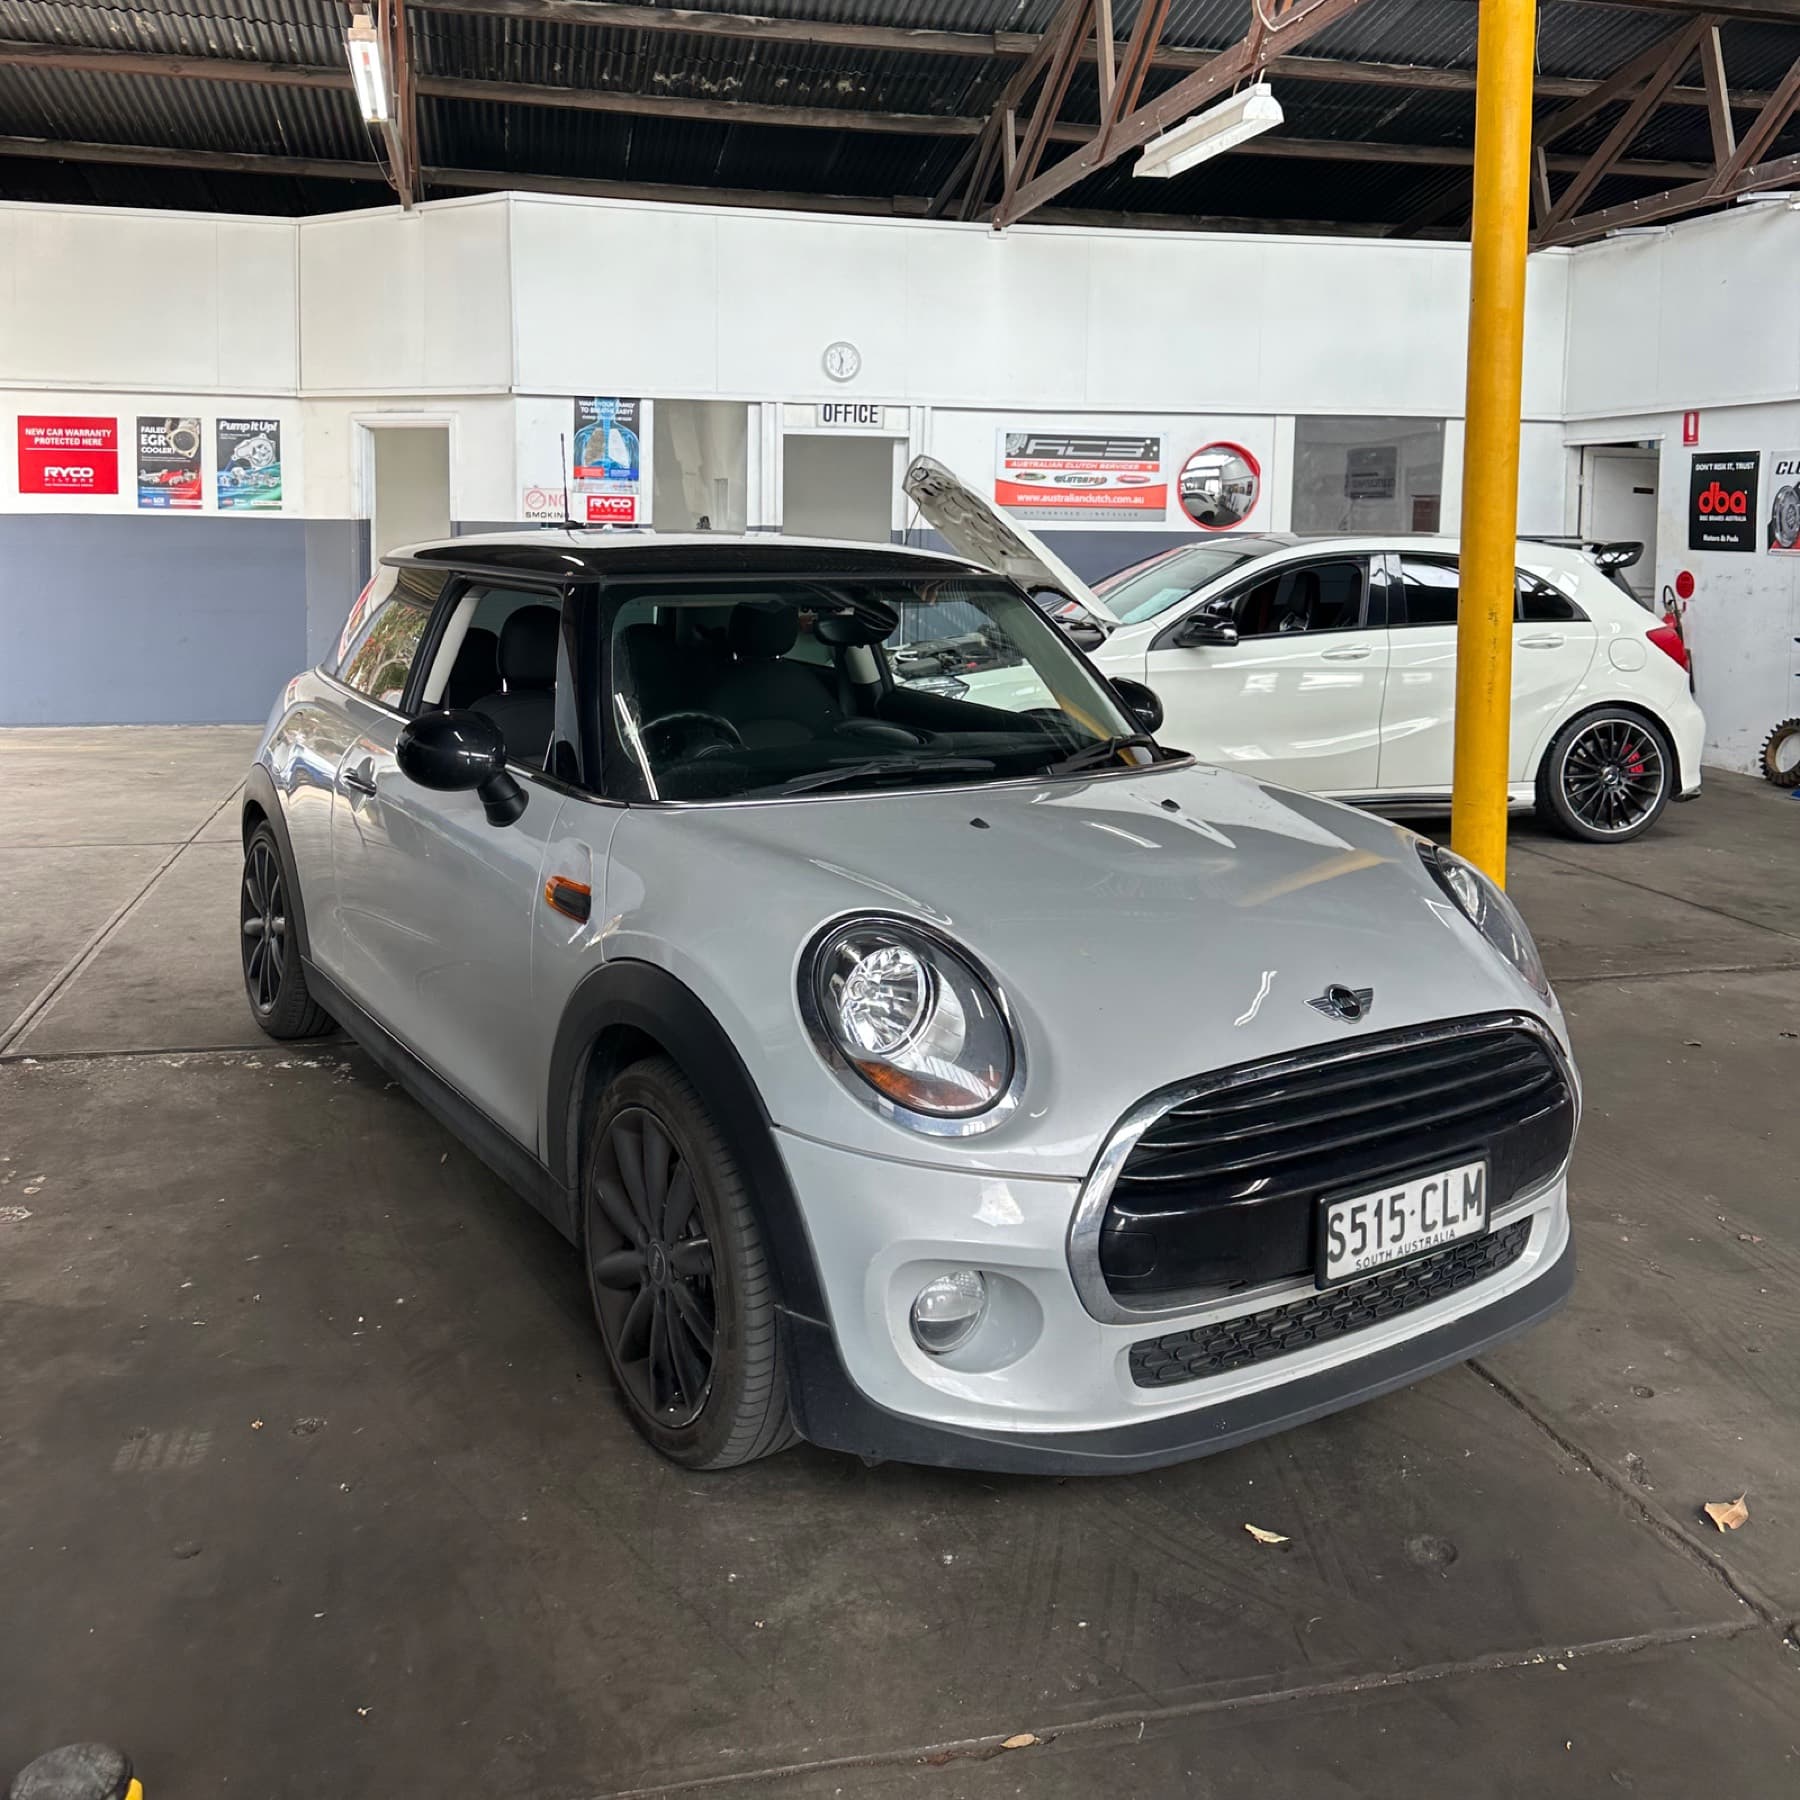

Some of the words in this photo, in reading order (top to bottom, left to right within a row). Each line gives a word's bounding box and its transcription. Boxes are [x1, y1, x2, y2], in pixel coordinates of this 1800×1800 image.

[823, 403, 879, 423] OFFICE
[25, 427, 45, 436] NEW
[46, 428, 64, 437] CAR
[65, 428, 112, 438] WARRANTY
[141, 426, 167, 434] FAILED
[219, 421, 250, 433] Pump
[34, 437, 81, 446] PROTECTED
[82, 438, 103, 447] HERE
[141, 434, 167, 446] EGR
[1010, 460, 1063, 469] AUSTRALIAN
[1064, 461, 1098, 470] CLUTCH
[1775, 461, 1800, 475] CL
[44, 466, 94, 477] RYCO
[589, 498, 632, 508] RYCO
[1017, 492, 1145, 504] www.australianclutch.com.au
[1698, 482, 1747, 513] dba
[1355, 1249, 1393, 1271] SOUTH
[1397, 1228, 1455, 1255] AUSTRALIA
